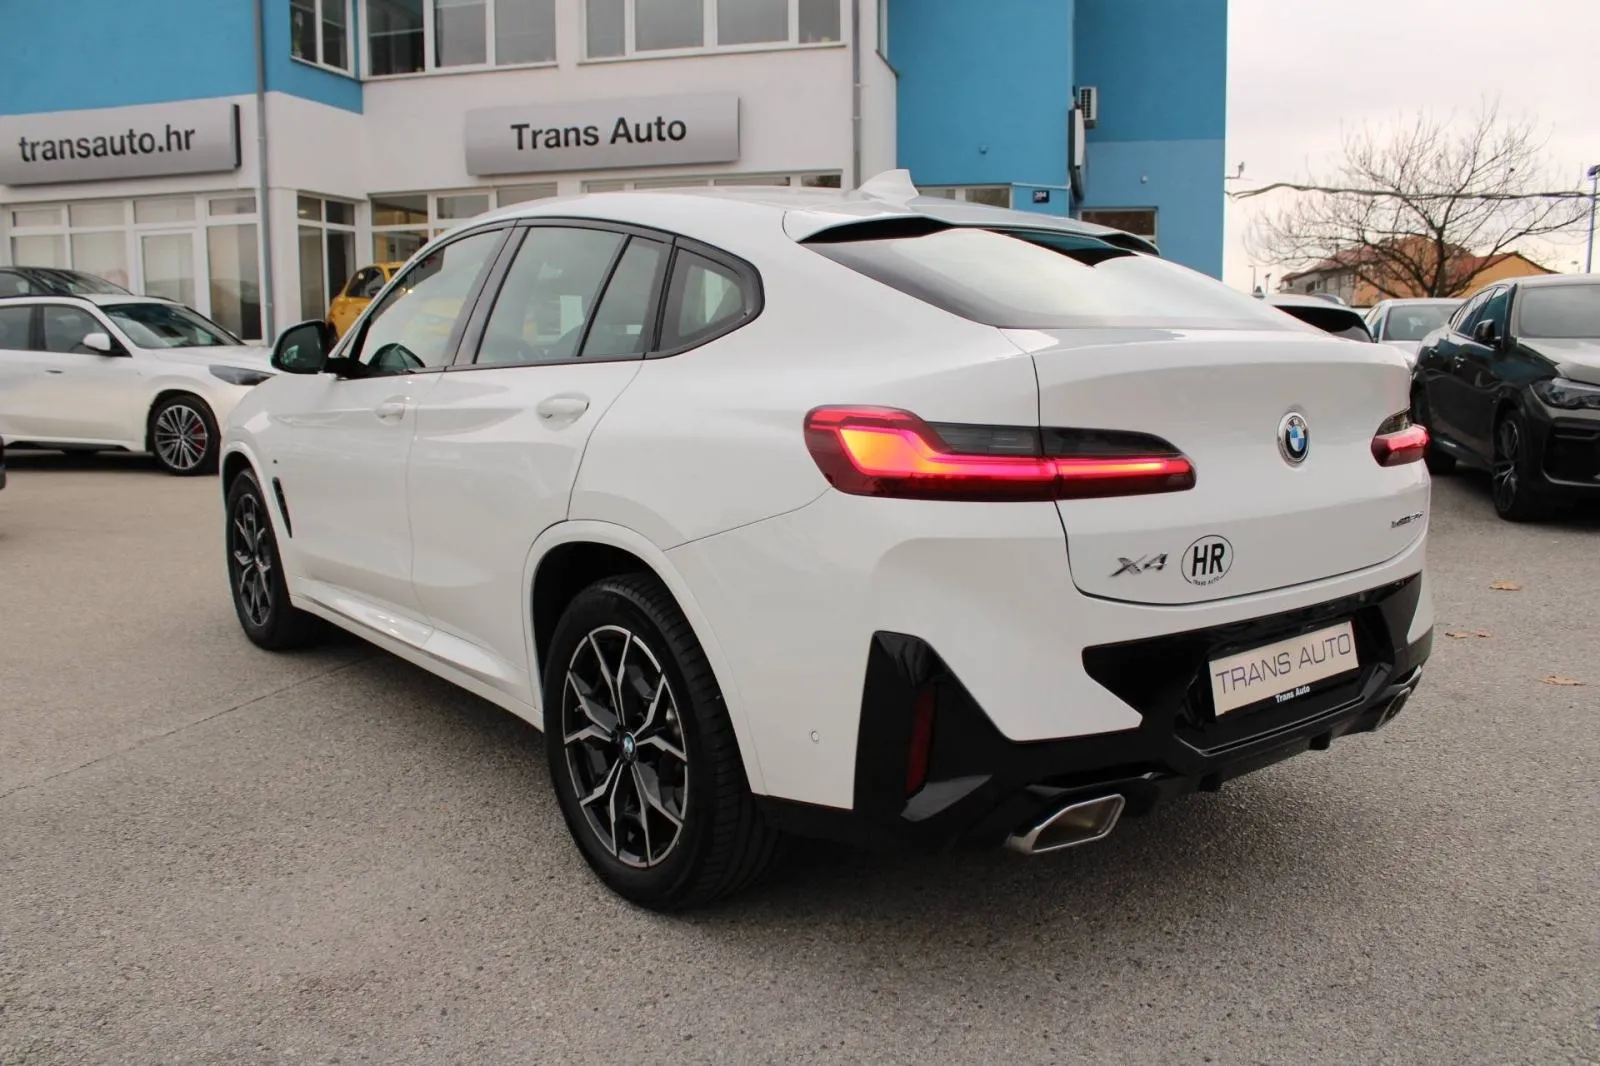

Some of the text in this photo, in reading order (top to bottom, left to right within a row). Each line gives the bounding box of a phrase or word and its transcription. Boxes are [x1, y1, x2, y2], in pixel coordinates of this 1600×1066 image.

[19, 124, 195, 162] transauto.hr
[511, 116, 686, 150] Trans Auto
[1109, 553, 1168, 577] X4
[1191, 543, 1225, 577] HR
[1215, 633, 1351, 694] TRANS AUTO
[1275, 685, 1310, 703] Trans Auto
